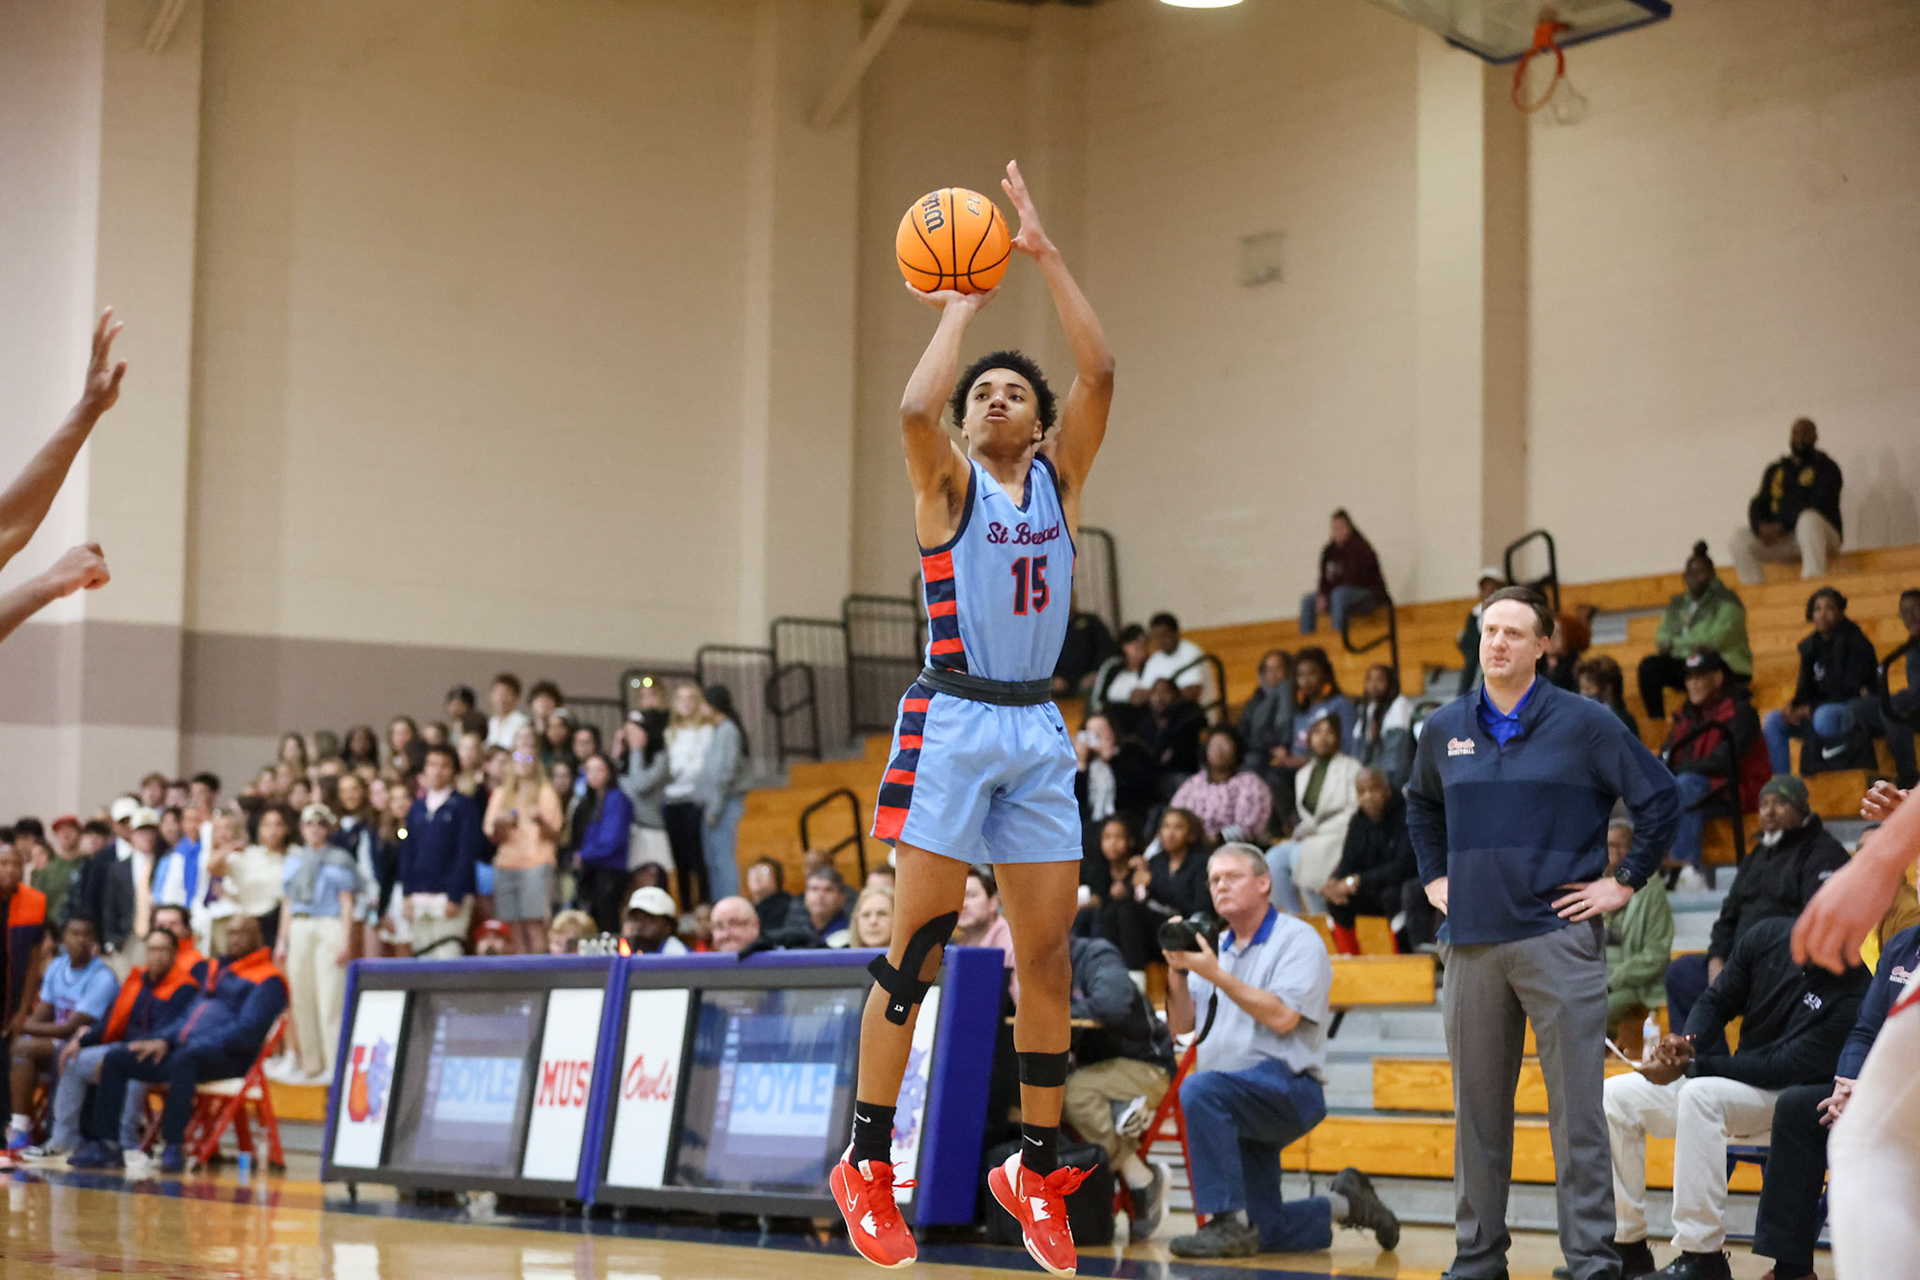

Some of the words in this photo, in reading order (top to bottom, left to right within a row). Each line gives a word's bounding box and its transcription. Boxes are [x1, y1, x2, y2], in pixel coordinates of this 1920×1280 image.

[986, 521, 1009, 544] St
[1011, 554, 1050, 616] 15
[438, 1057, 521, 1103] BOYLE
[537, 1060, 591, 1108] MUS
[621, 1053, 674, 1101] Owls
[731, 1063, 832, 1115] BOYLE
